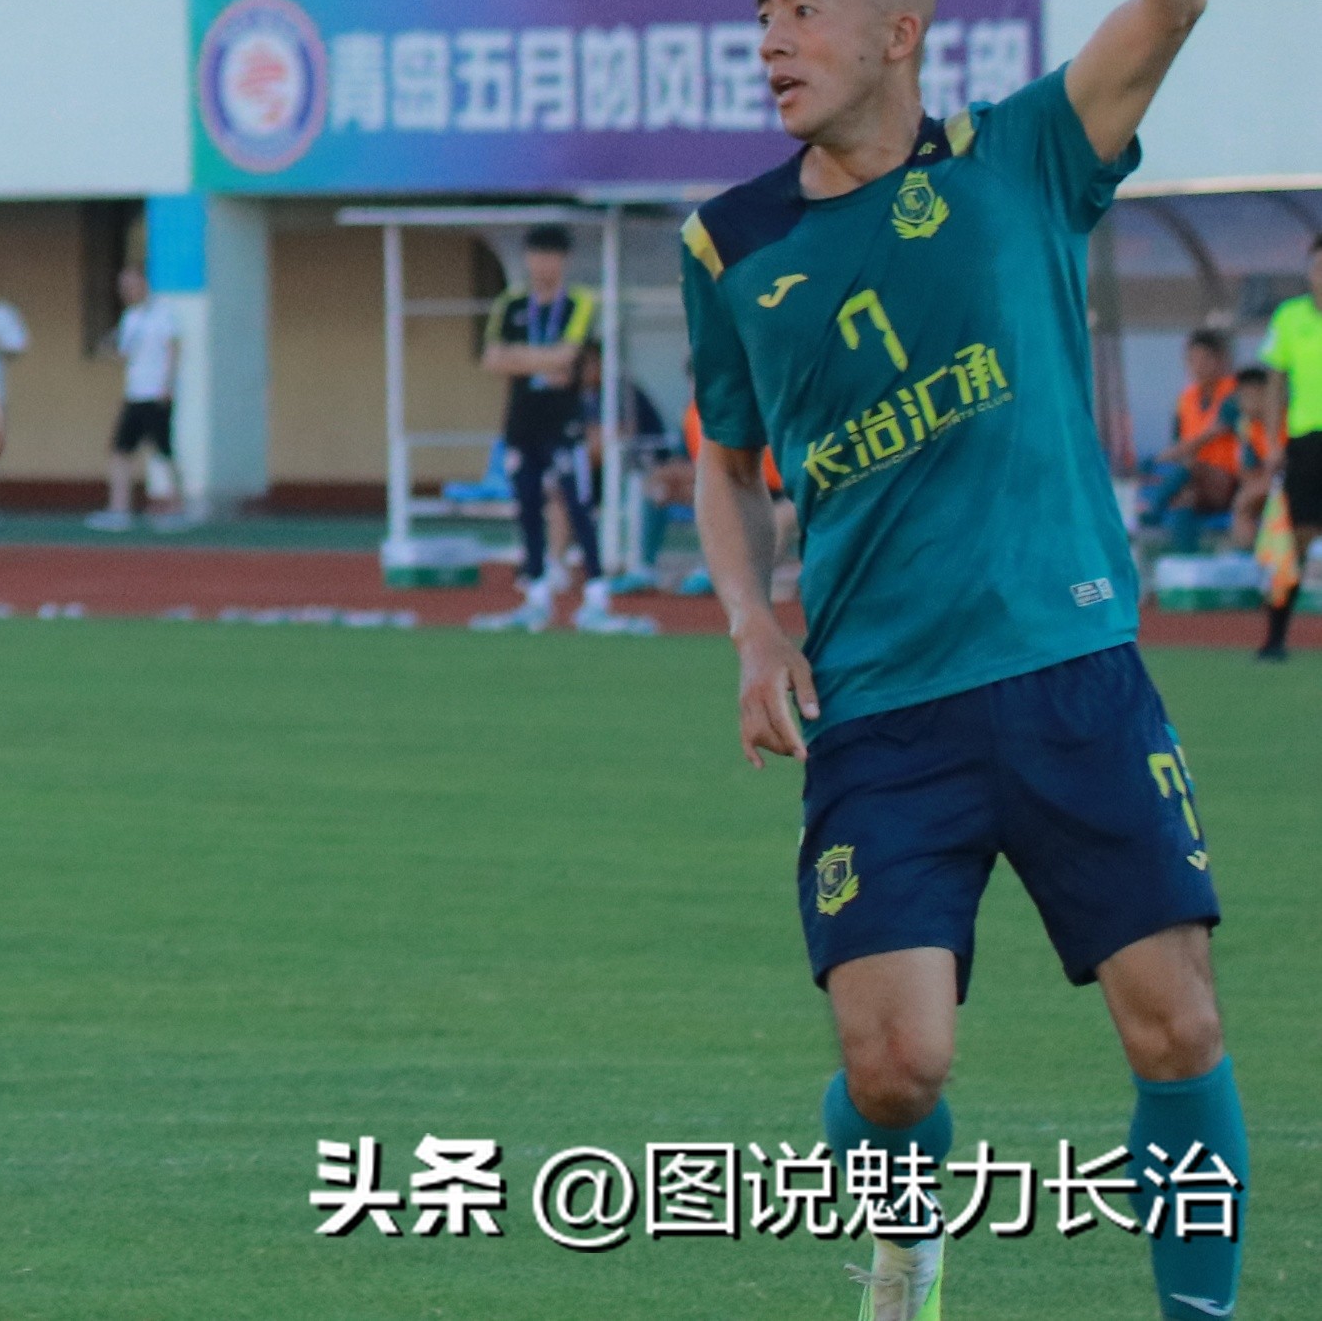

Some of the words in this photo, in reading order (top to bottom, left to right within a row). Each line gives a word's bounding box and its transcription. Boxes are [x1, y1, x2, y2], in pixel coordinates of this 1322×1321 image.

[331, 20, 1031, 133] 青岛五月的风足乐部
[836, 288, 908, 372] 7
[803, 343, 1009, 490] 长治汇承
